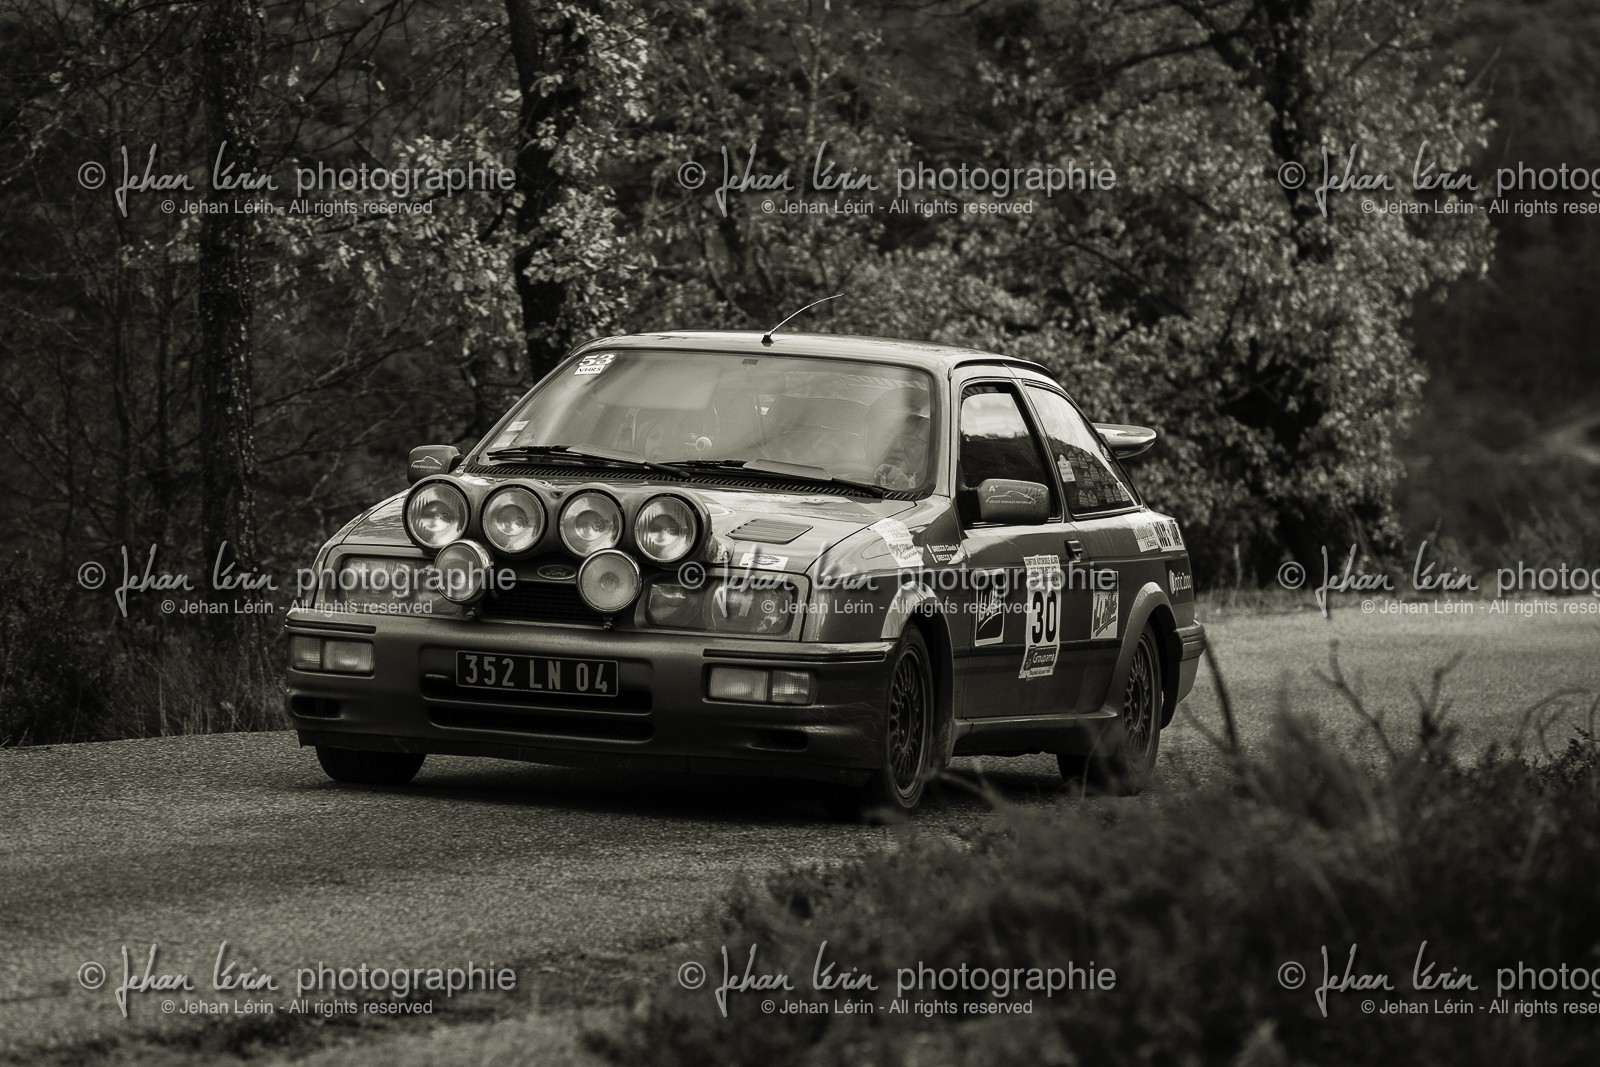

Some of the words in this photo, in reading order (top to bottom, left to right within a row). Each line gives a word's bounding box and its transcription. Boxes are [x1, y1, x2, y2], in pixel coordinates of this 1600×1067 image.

[579, 354, 615, 366] 53
[1031, 591, 1057, 644] 30
[465, 655, 514, 687] 352
[529, 660, 561, 690] LN
[576, 663, 607, 692] 04
